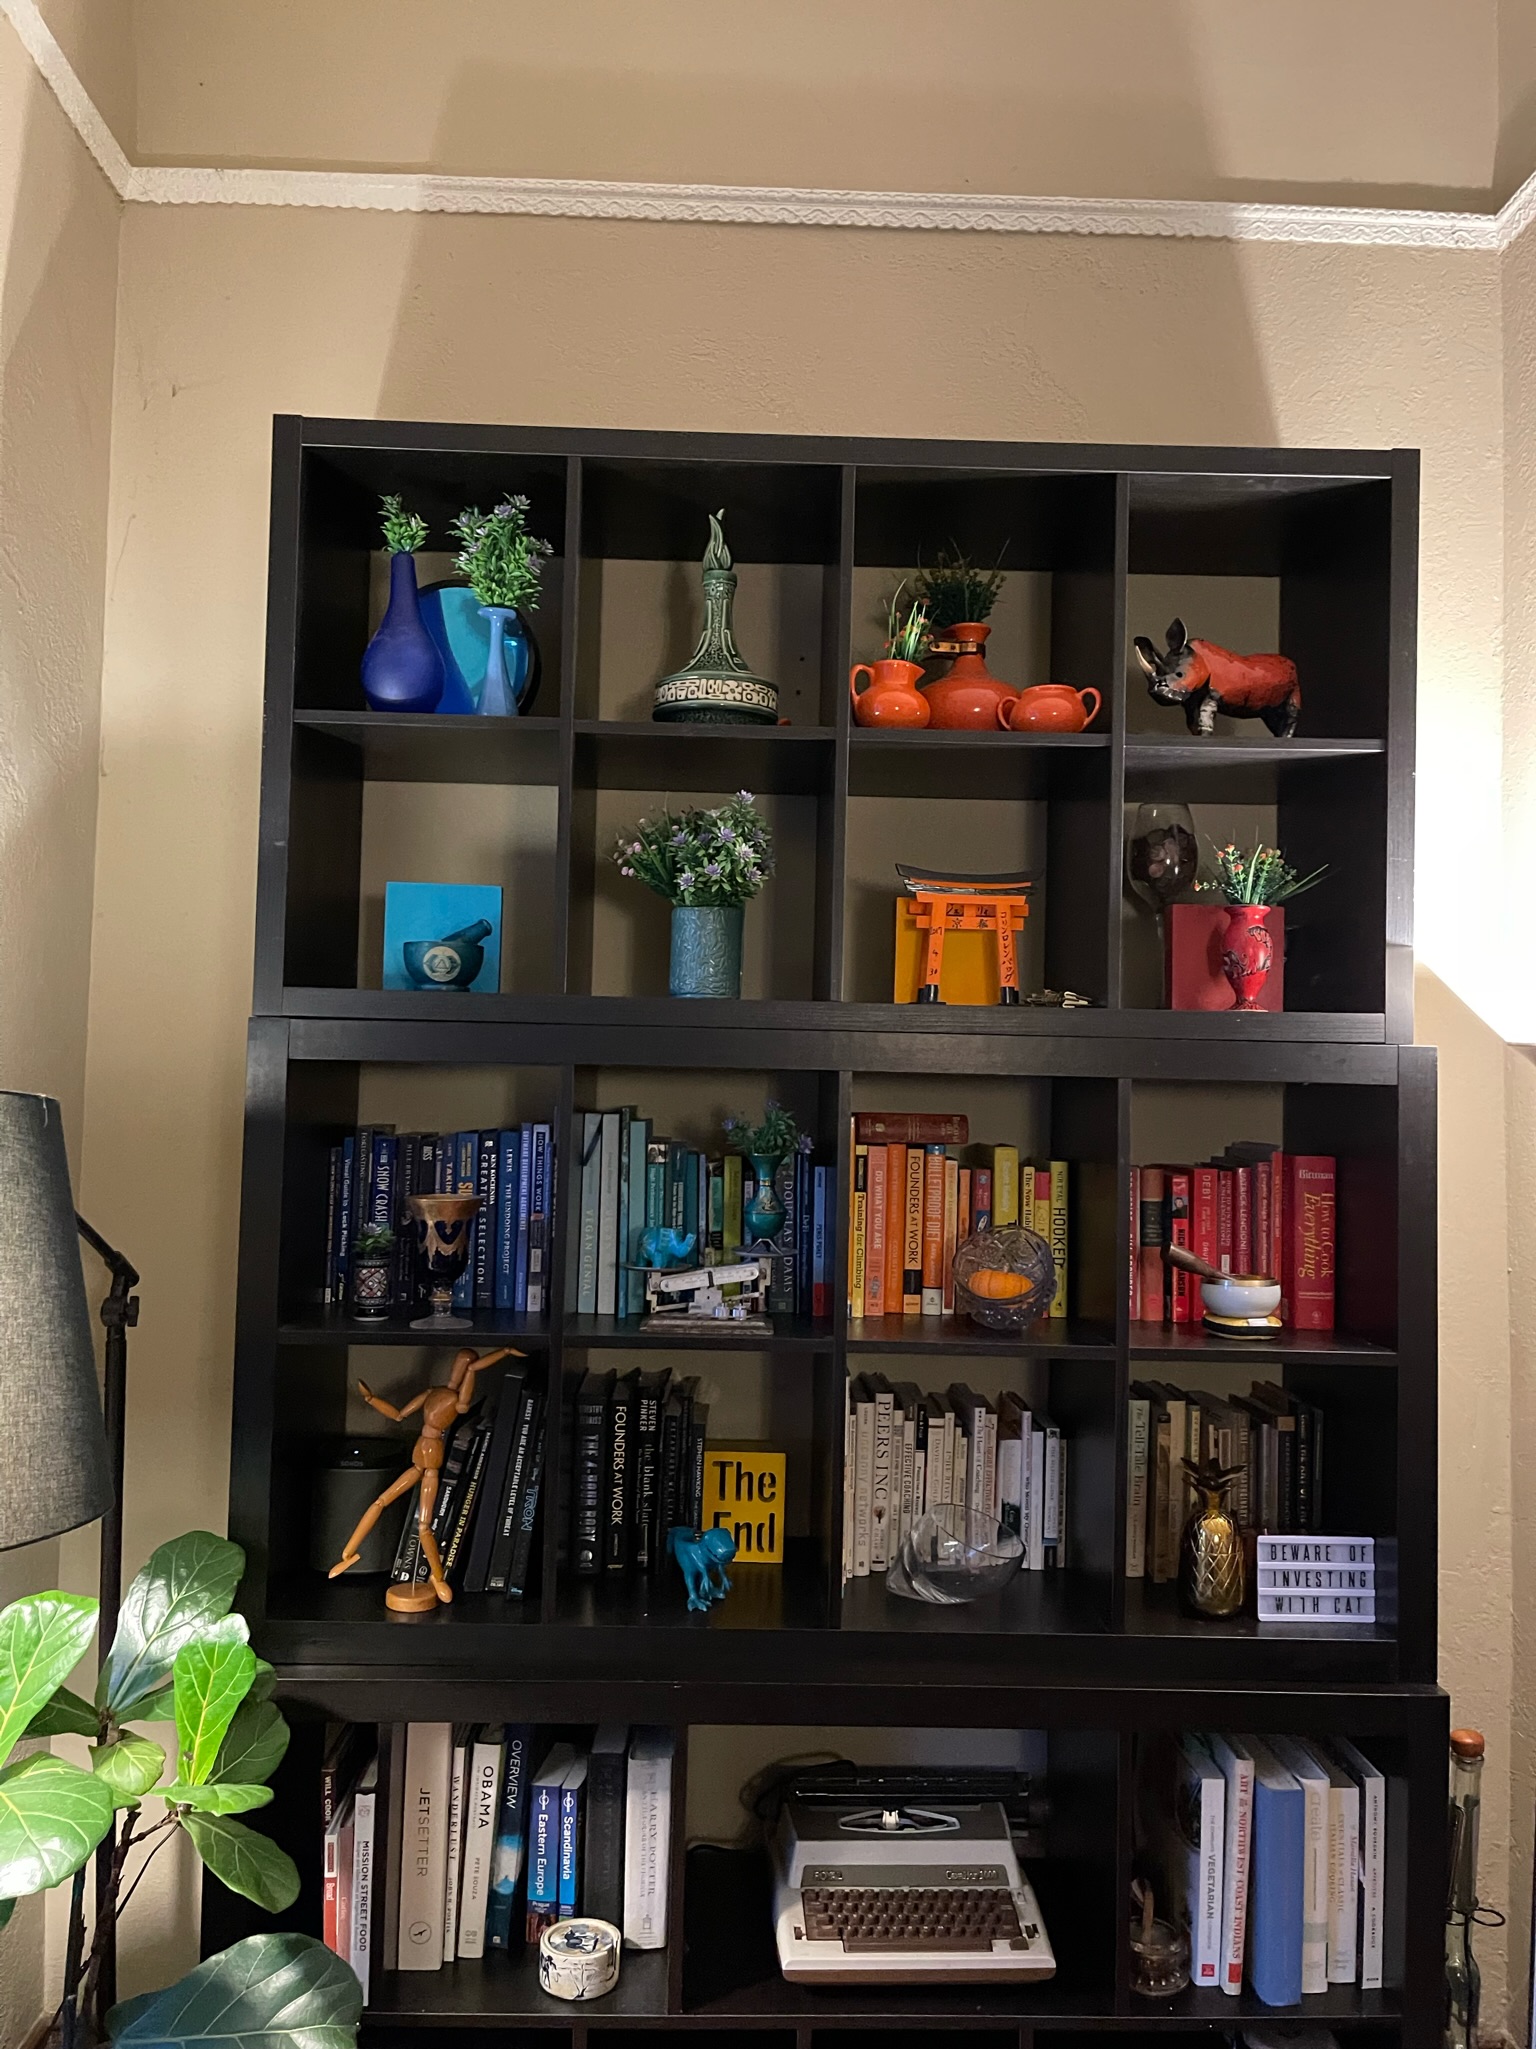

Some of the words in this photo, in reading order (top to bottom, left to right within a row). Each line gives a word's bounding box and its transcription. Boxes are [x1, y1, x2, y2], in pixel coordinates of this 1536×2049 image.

[535, 1133, 545, 1152] HOW
[506, 1148, 514, 1173] LEWIS
[535, 1154, 544, 1185] THINGS
[875, 1170, 882, 1183] DO
[342, 1180, 351, 1198] Guide
[376, 1166, 389, 1190] SNOW
[504, 1183, 512, 1199] THE
[908, 1156, 920, 1214] FOUNDERS
[926, 1156, 943, 1220] BULLETPROOF
[1025, 1172, 1033, 1187] The
[1202, 1175, 1212, 1200] DEBT
[1239, 1172, 1248, 1206] PATRICK
[374, 1193, 388, 1222] CRASH
[534, 1188, 543, 1211] WORK
[856, 1192, 865, 1232] Training
[874, 1185, 882, 1211] WHAT
[1321, 1192, 1334, 1223] How
[585, 1209, 594, 1250] VEGAN
[873, 1213, 881, 1230] YOU
[910, 1216, 918, 1227] AT
[926, 1221, 940, 1242] DIET
[1024, 1209, 1032, 1230] Habi
[1052, 1206, 1066, 1267] HOOKED
[1238, 1208, 1247, 1250] LENCIONI
[1298, 1192, 1321, 1280] Everything
[1321, 1226, 1330, 1239] to
[477, 1217, 487, 1284] SELECTION
[873, 1231, 881, 1249] ARE
[907, 1229, 919, 1264] WORK
[501, 1241, 511, 1275] PROJECT
[854, 1248, 864, 1289] Climbing
[1320, 1240, 1334, 1278] Cook
[639, 1399, 648, 1432] PINKER
[648, 1399, 657, 1432] STEVEN
[876, 1401, 892, 1459] PEERS
[580, 1434, 600, 1457] THE
[612, 1406, 627, 1470] FOUNDERS
[644, 1444, 655, 1461] the
[696, 1438, 704, 1469] STEPHEN
[511, 1455, 524, 1489] ACCEPTABLE
[857, 1430, 873, 1482] uncanny
[903, 1442, 914, 1480] EFFECTIVE
[613, 1472, 623, 1484] AT
[643, 1466, 655, 1498] blank
[694, 1468, 703, 1498] HAWKING
[712, 1460, 777, 1503] The
[874, 1465, 889, 1500] INC
[973, 1464, 983, 1495] Coaching
[1132, 1474, 1145, 1507] Brain
[461, 1481, 477, 1515] HUNGER
[507, 1489, 517, 1507] LEVEL
[520, 1485, 539, 1532] TRON
[610, 1486, 623, 1525] WORK
[902, 1480, 912, 1514] COACHING
[458, 1516, 467, 1526] IN
[502, 1515, 512, 1537] THREAT
[641, 1502, 653, 1528] slate
[857, 1490, 870, 1547] networks
[445, 1527, 463, 1568] PARADISE
[1269, 1544, 1332, 1562] BEWARE
[1349, 1545, 1367, 1562] OF
[1272, 1570, 1367, 1588] INVESTING
[1334, 1597, 1363, 1614] CAT
[324, 1775, 333, 1797] WILL
[506, 1739, 523, 1809] OVERVIEW
[1239, 1773, 1249, 1794] ART
[324, 1798, 334, 1822] COOK
[477, 1765, 494, 1829] OBAMA
[416, 1787, 431, 1877] JETSETTER
[448, 1775, 461, 1861] WANDERLUST
[649, 1790, 658, 1841] HARRY
[1310, 1792, 1323, 1842] create
[538, 1813, 549, 1853] Eastern
[562, 1816, 574, 1880] Scandinavia
[1236, 1811, 1248, 1876] NORTHWEST
[361, 1840, 370, 1882] MISSION
[535, 1857, 547, 1896] Europe
[647, 1845, 656, 1897] POTTER
[359, 1884, 369, 1921] STREET
[1206, 1854, 1217, 1919] VEGETARIAN
[1234, 1879, 1245, 1913] COAST
[359, 1923, 368, 1952] FOOD
[1232, 1916, 1243, 1959] INDIANS
